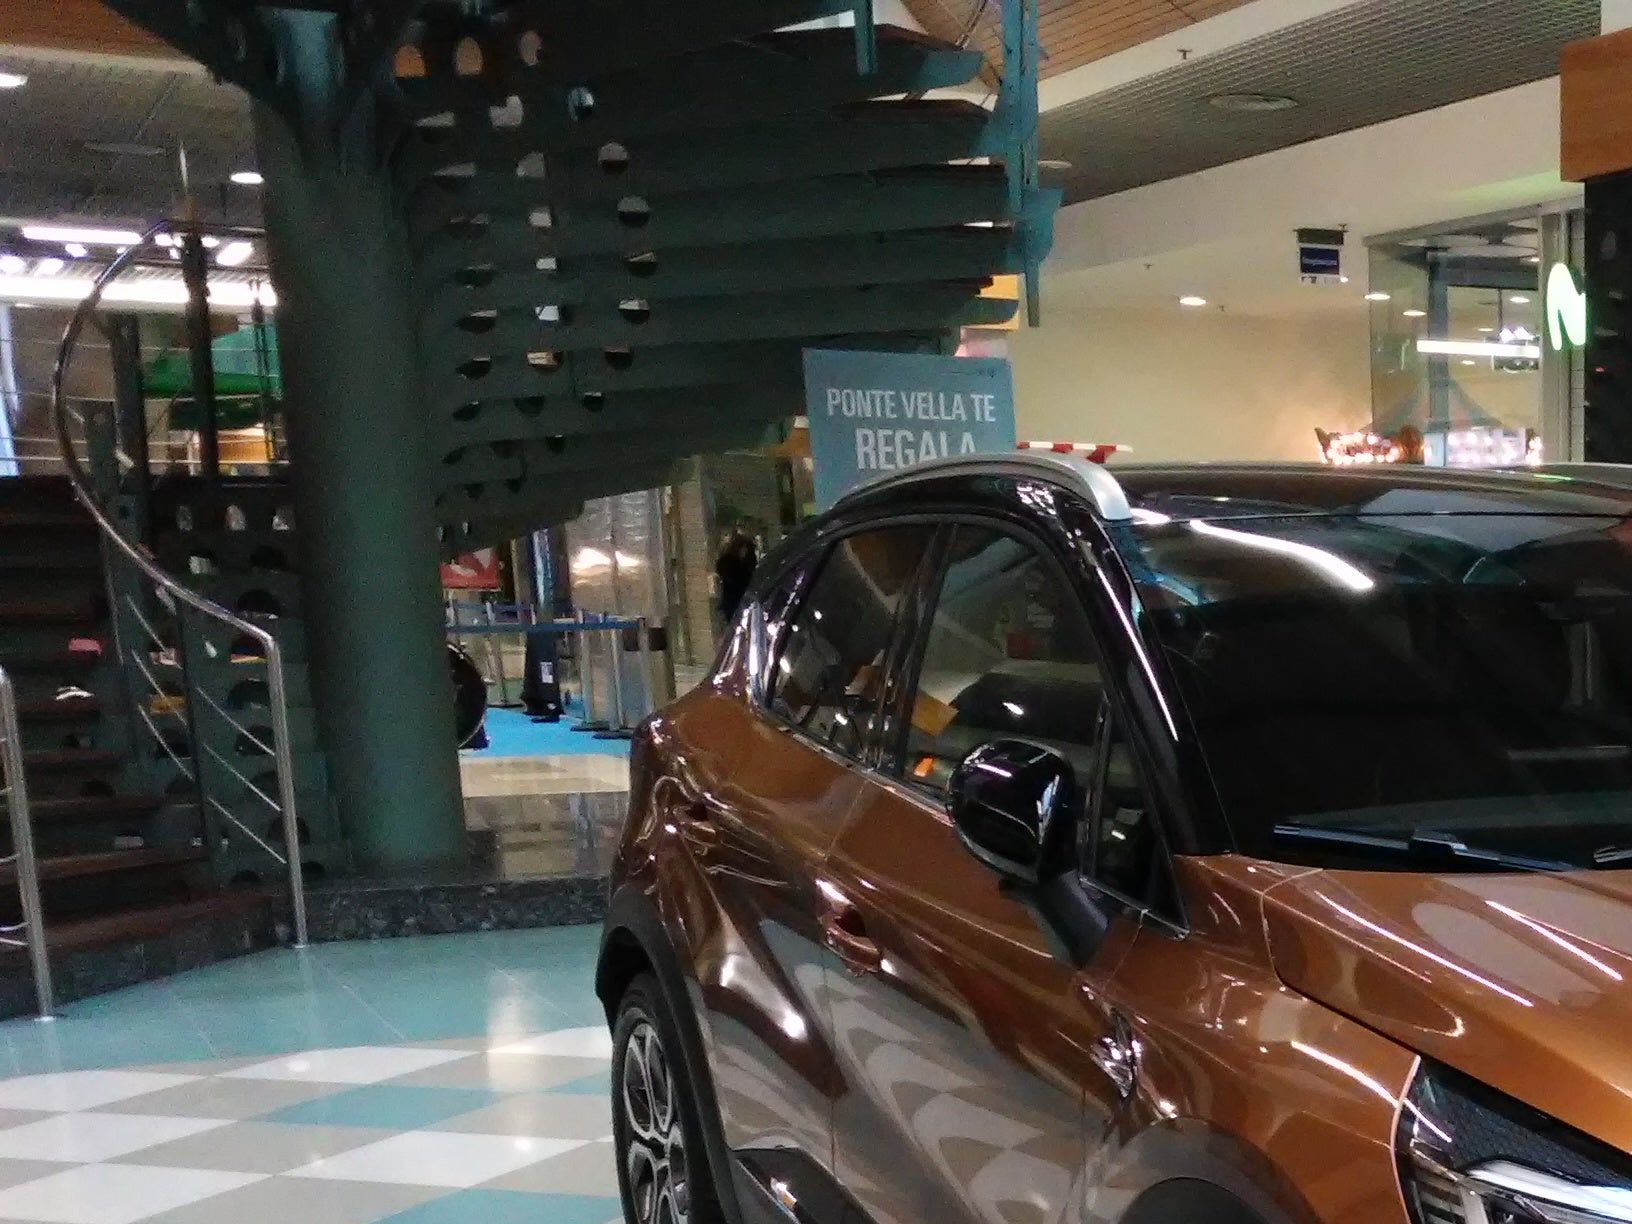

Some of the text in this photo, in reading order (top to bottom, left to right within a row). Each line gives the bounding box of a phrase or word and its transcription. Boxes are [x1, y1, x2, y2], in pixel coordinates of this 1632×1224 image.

[826, 388, 997, 422] PONTE VELLA TE
